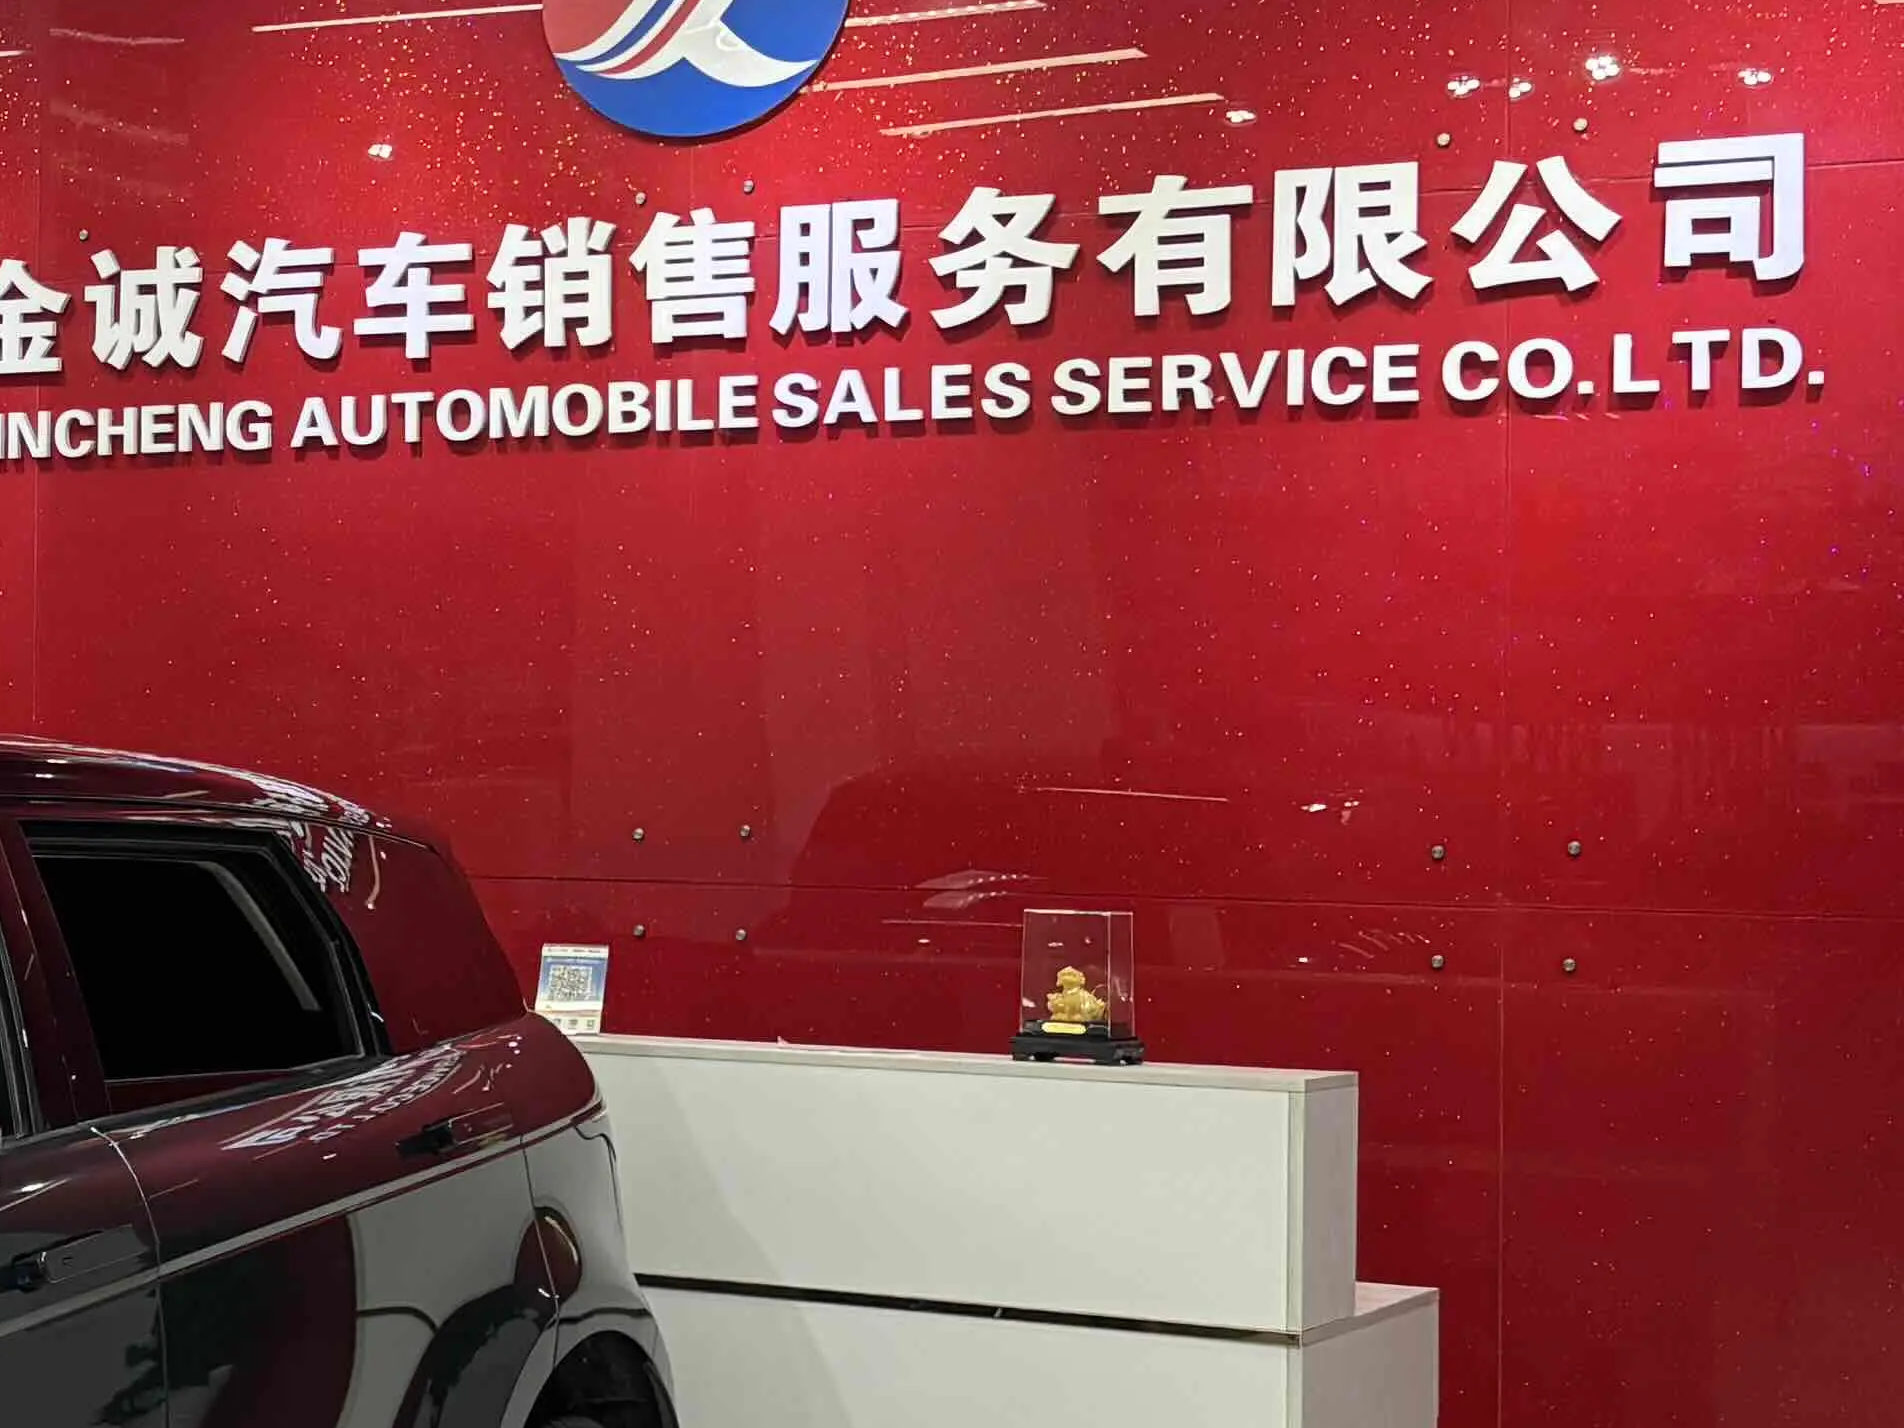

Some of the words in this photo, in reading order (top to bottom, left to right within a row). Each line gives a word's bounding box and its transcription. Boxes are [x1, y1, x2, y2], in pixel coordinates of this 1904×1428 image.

[290, 373, 759, 450] AUTOMOBILE
[773, 361, 1033, 430] SALES
[1050, 342, 1422, 418] SERVICE
